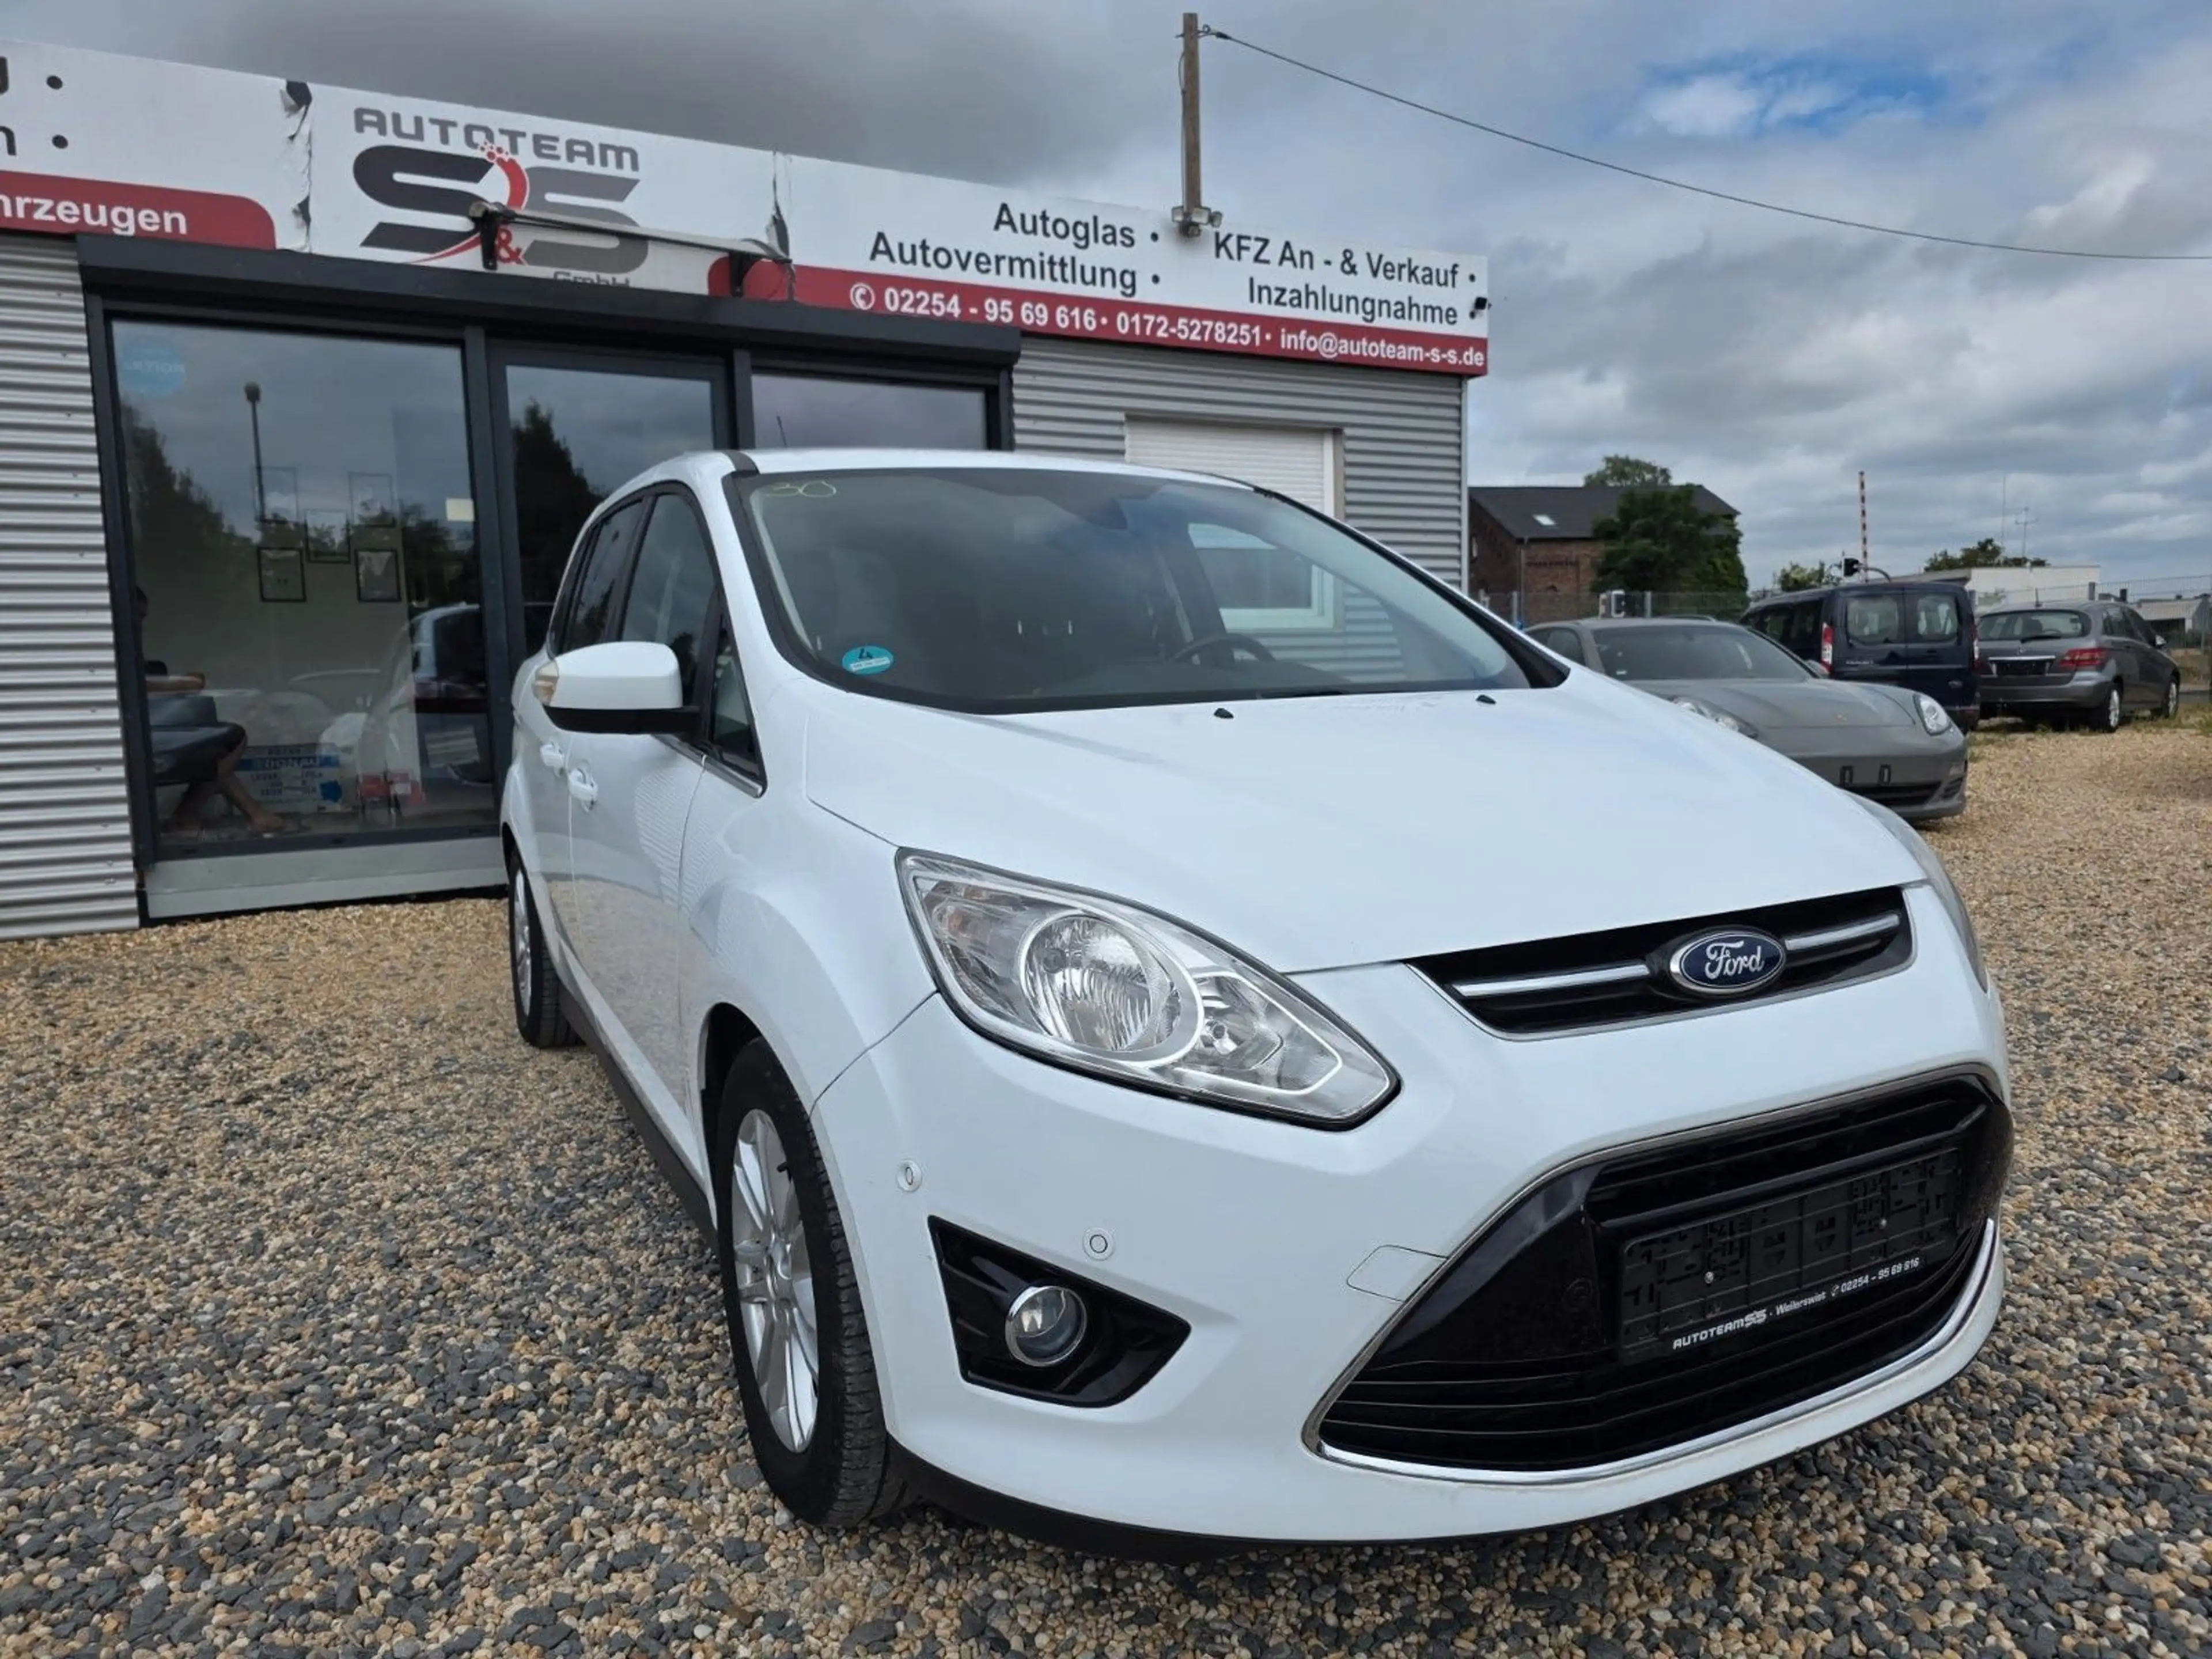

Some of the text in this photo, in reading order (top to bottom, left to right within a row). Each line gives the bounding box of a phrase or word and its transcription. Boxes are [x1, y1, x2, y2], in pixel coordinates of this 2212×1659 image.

[354, 107, 639, 172] AUTOTEAM
[993, 203, 1135, 250] Autoglas
[869, 231, 1137, 298] Autovermittlung
[1214, 232, 1271, 264] KFZ
[1278, 241, 1314, 270] An
[1340, 248, 1358, 275] &
[1366, 252, 1459, 289] Verkauf
[1248, 277, 1458, 325] Inzahlungnahme
[884, 287, 961, 318] 02254
[984, 298, 1013, 323] 95
[1020, 302, 1048, 327] 69
[1055, 306, 1096, 331] 616
[1116, 312, 1261, 346] 0172-5278251
[1280, 328, 1484, 368] info@autoteam-s-s.de
[1705, 940, 1765, 979] Ford
[1841, 1274, 1869, 1293] 02254
